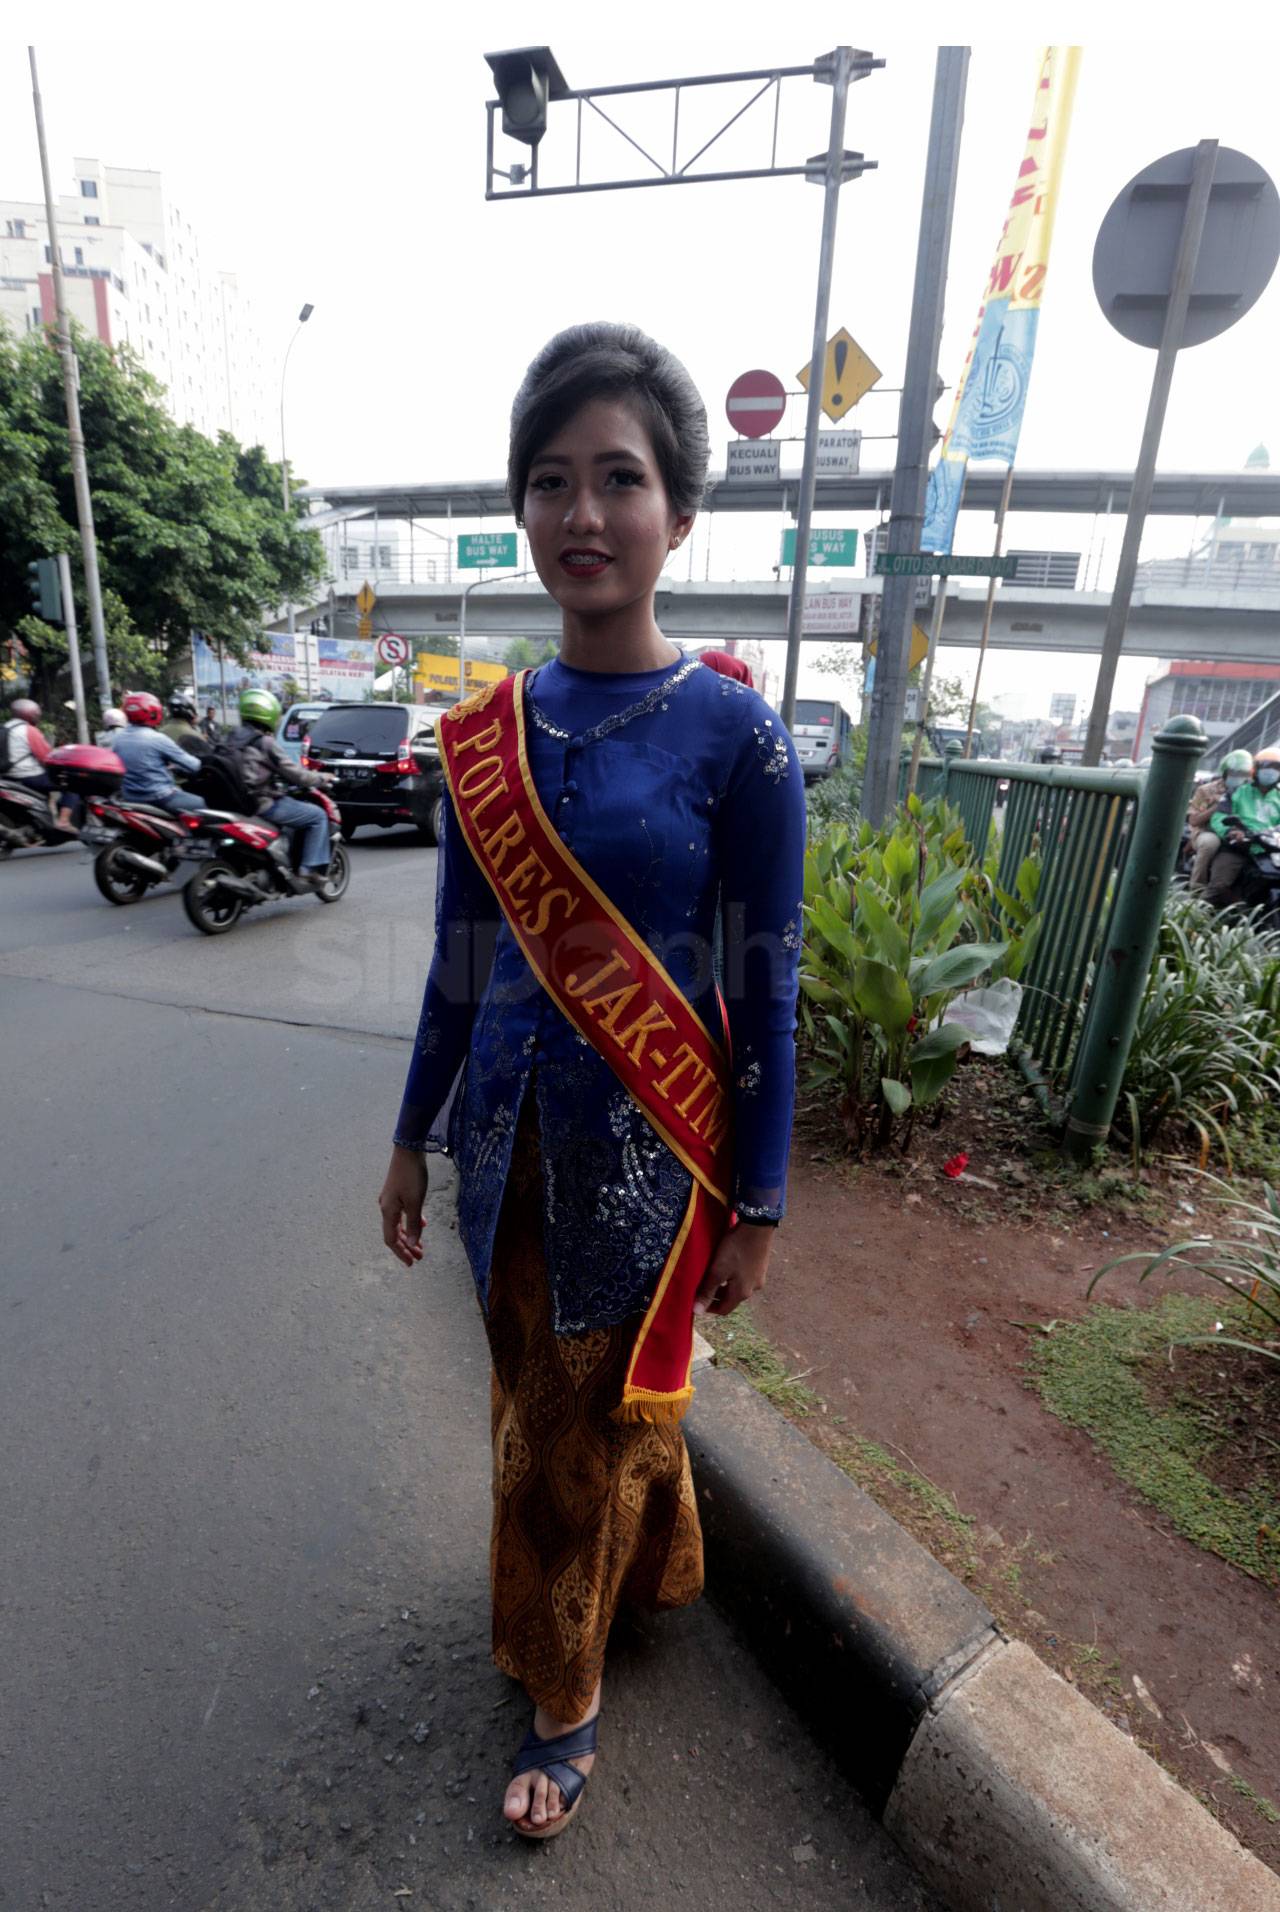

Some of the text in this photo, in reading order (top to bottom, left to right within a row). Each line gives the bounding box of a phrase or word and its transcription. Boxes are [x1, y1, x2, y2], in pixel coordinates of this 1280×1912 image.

[819, 437, 859, 448] PARATOR
[729, 448, 778, 460] KECUALI
[472, 535, 502, 545] HALTE
[808, 530, 845, 541] USUS
[467, 546, 508, 557] BUS WAY
[822, 542, 846, 553] WAY
[893, 556, 921, 574] OTTO
[922, 556, 976, 574] ISKANDAR
[976, 557, 1014, 576] DINATA
[452, 718, 729, 1157] POLRES JAK-TIM
